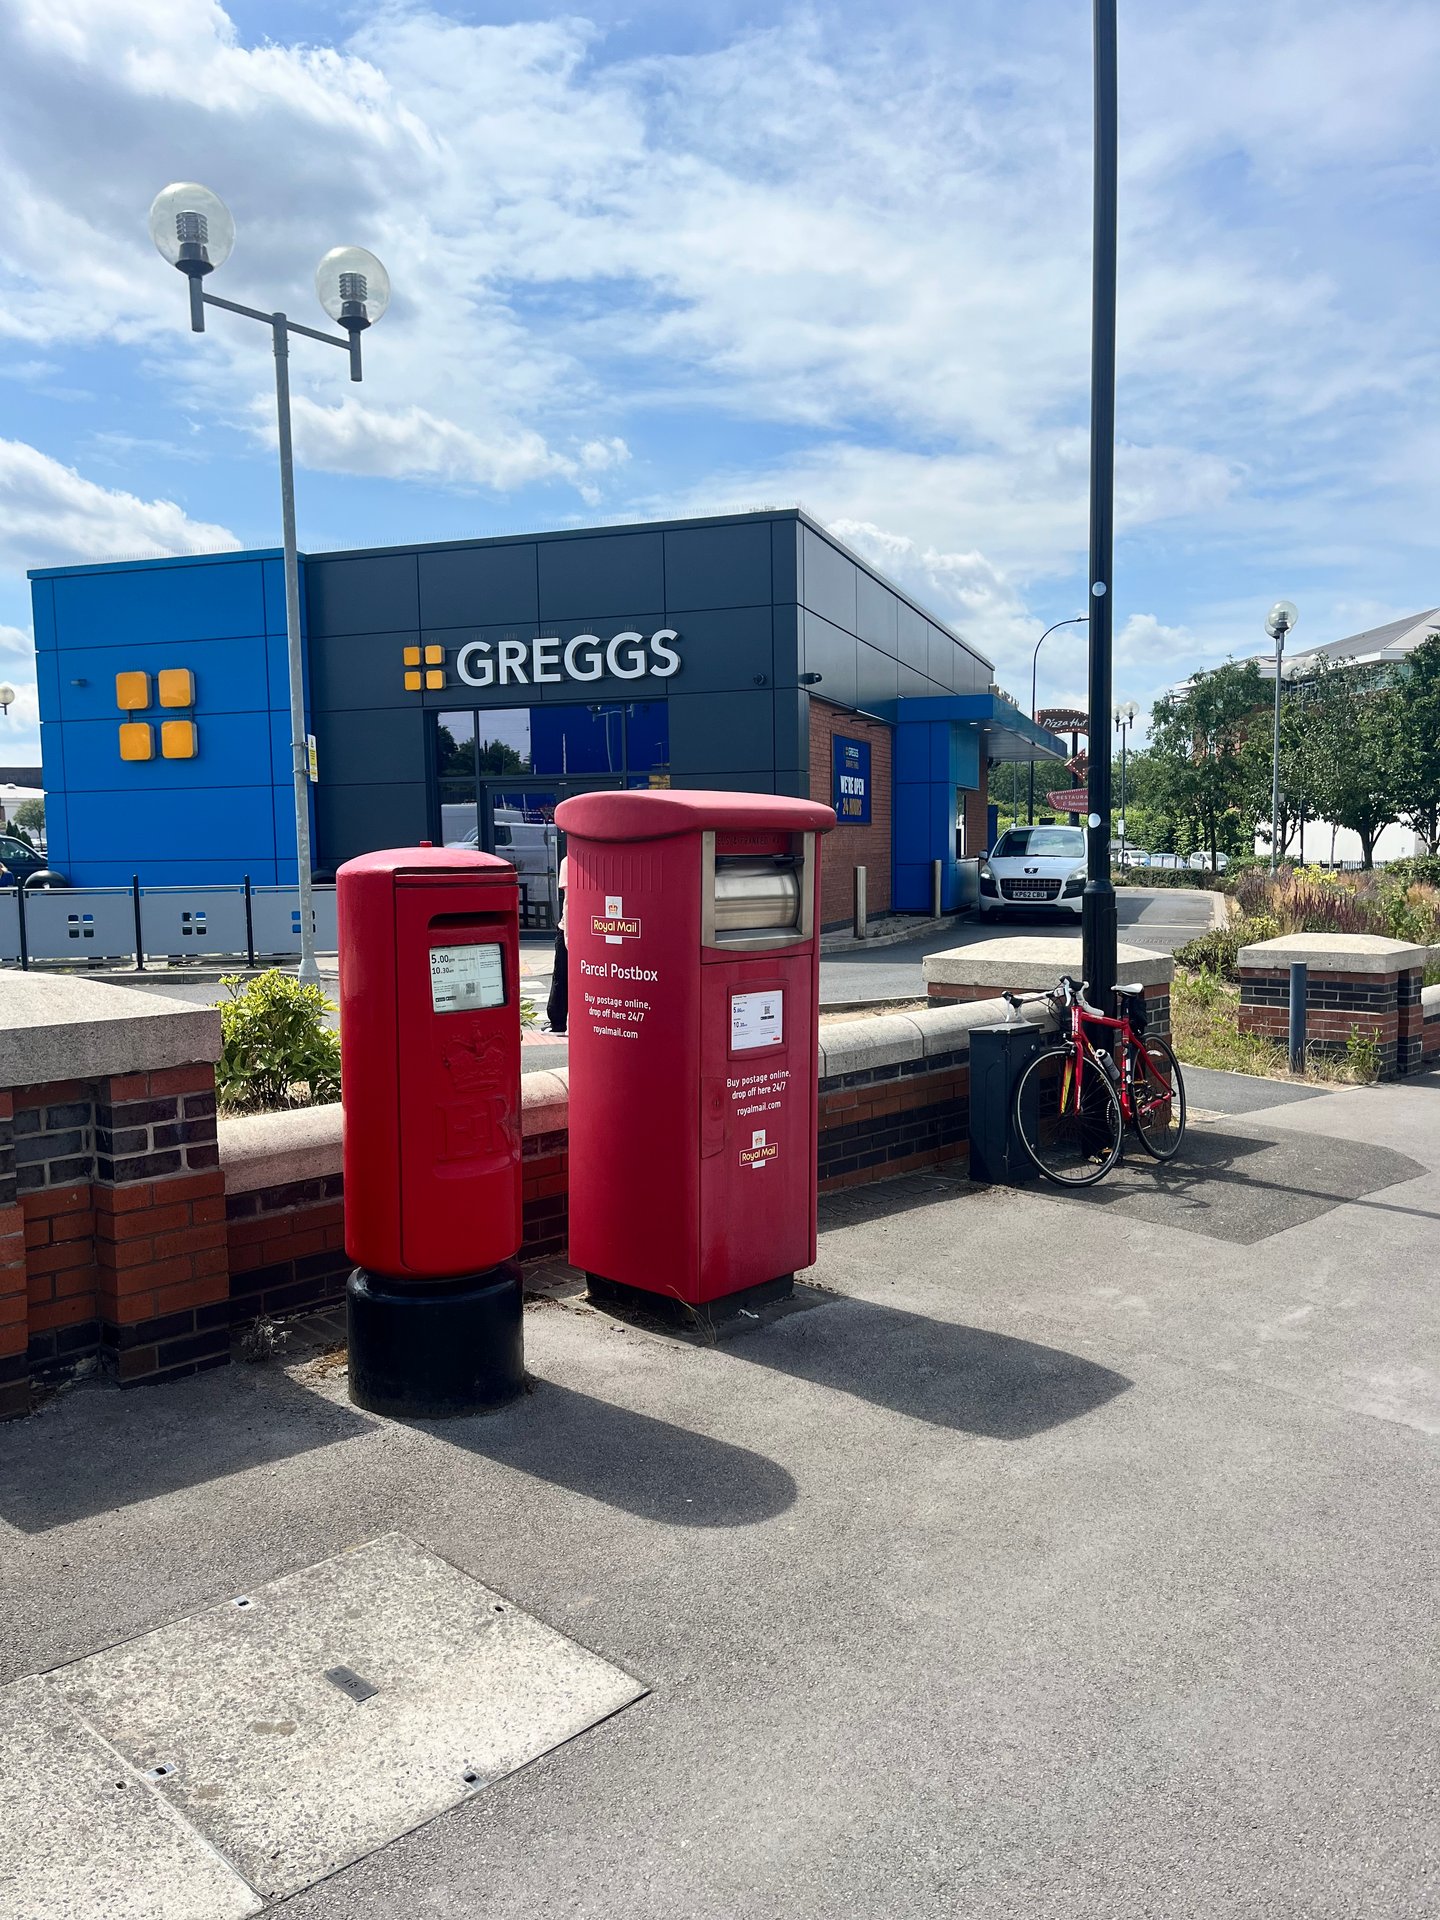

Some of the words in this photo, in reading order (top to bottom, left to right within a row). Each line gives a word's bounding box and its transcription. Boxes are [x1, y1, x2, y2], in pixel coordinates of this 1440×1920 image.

[456, 629, 681, 687] GREGGS
[1043, 718, 1069, 728] Pizza
[1069, 718, 1088, 727] Hut
[853, 777, 865, 796] OPEN
[593, 919, 616, 933] Royal
[617, 922, 637, 933] Mail
[580, 960, 607, 978] Parcel
[611, 963, 658, 982] Postbox
[584, 992, 595, 1004] Buy
[597, 996, 622, 1007] postage
[624, 998, 651, 1010] online,
[589, 1006, 601, 1018] drop
[602, 1009, 611, 1018] off
[612, 1011, 626, 1020] here
[628, 1012, 645, 1022] 24/7
[593, 1025, 638, 1039] royalmail.com
[726, 1078, 740, 1088] Buy
[741, 1074, 768, 1086] postage
[731, 1089, 747, 1099] drop
[748, 1087, 757, 1097] off
[758, 1085, 771, 1095] here
[772, 1081, 786, 1092] 24/7
[737, 1101, 781, 1116] royalmail.com
[741, 1151, 761, 1162] Royal
[761, 1146, 776, 1157] Mail
